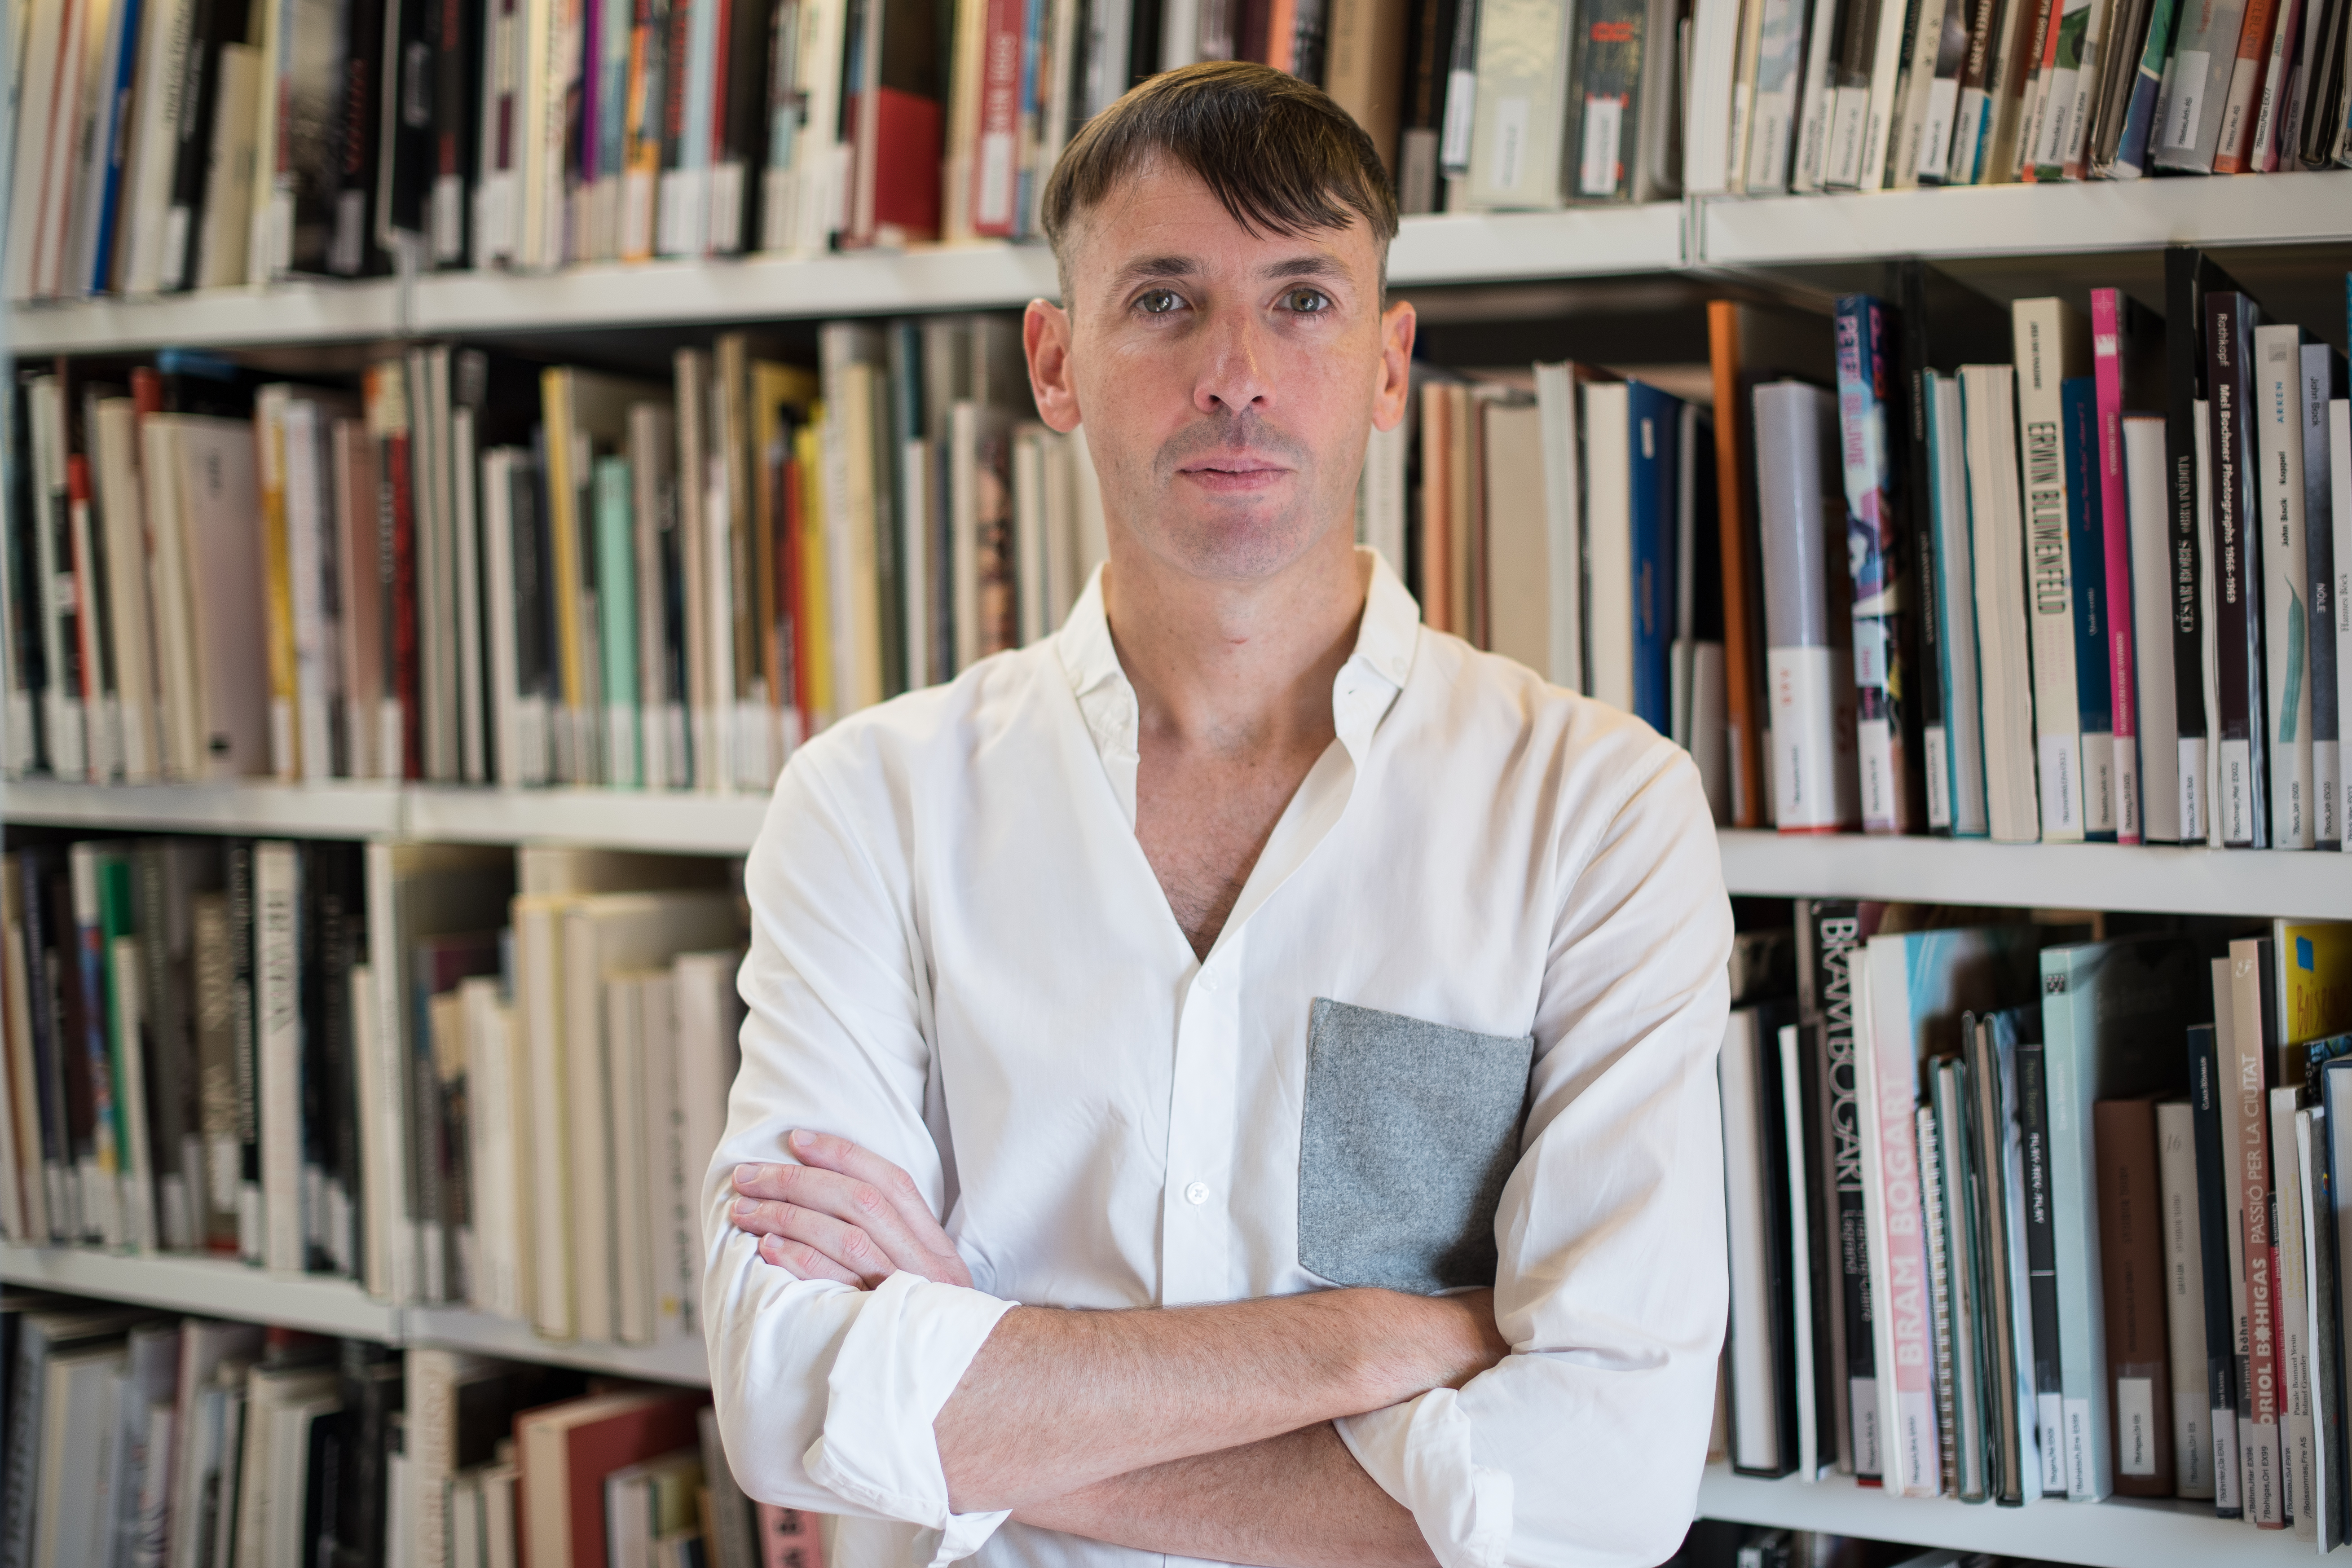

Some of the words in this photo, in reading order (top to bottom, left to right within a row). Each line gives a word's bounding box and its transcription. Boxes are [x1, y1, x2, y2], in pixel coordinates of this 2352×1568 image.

[1839, 316, 1859, 383] PETER
[2216, 313, 2229, 367] Rothkopf
[2219, 384, 2230, 409] Mel
[2275, 382, 2284, 424] ARKEN
[2309, 376, 2320, 400] John
[2220, 410, 2231, 461] Bochner
[2311, 402, 2320, 427] Bock
[2028, 422, 2059, 484] ERWIN
[2220, 463, 2235, 543] Photographs
[2032, 491, 2066, 615] BLUMENFELD
[1821, 917, 1859, 1031] BRAM
[2241, 1051, 2260, 1116] CIUTAT
[1828, 1036, 1862, 1192] BOGART
[2246, 1120, 2260, 1144] LA
[1882, 1075, 1916, 1236] BOGART
[2247, 1149, 2262, 1180] PER
[2246, 1186, 2265, 1244] PASSIÓ
[1840, 1210, 1858, 1274] Legrand
[1891, 1256, 1925, 1367] BRAM
[2239, 1317, 2249, 1352] böhm
[2256, 1363, 2273, 1425] ORIOL
[2299, 1355, 2308, 1389] Cosandey
[2260, 1446, 2269, 1467] EX99
[2300, 1437, 2307, 1448] AS
[2247, 1469, 2257, 1514] 7Böhm,Har
[2261, 1469, 2272, 1520] 7Bohigas,Ori
